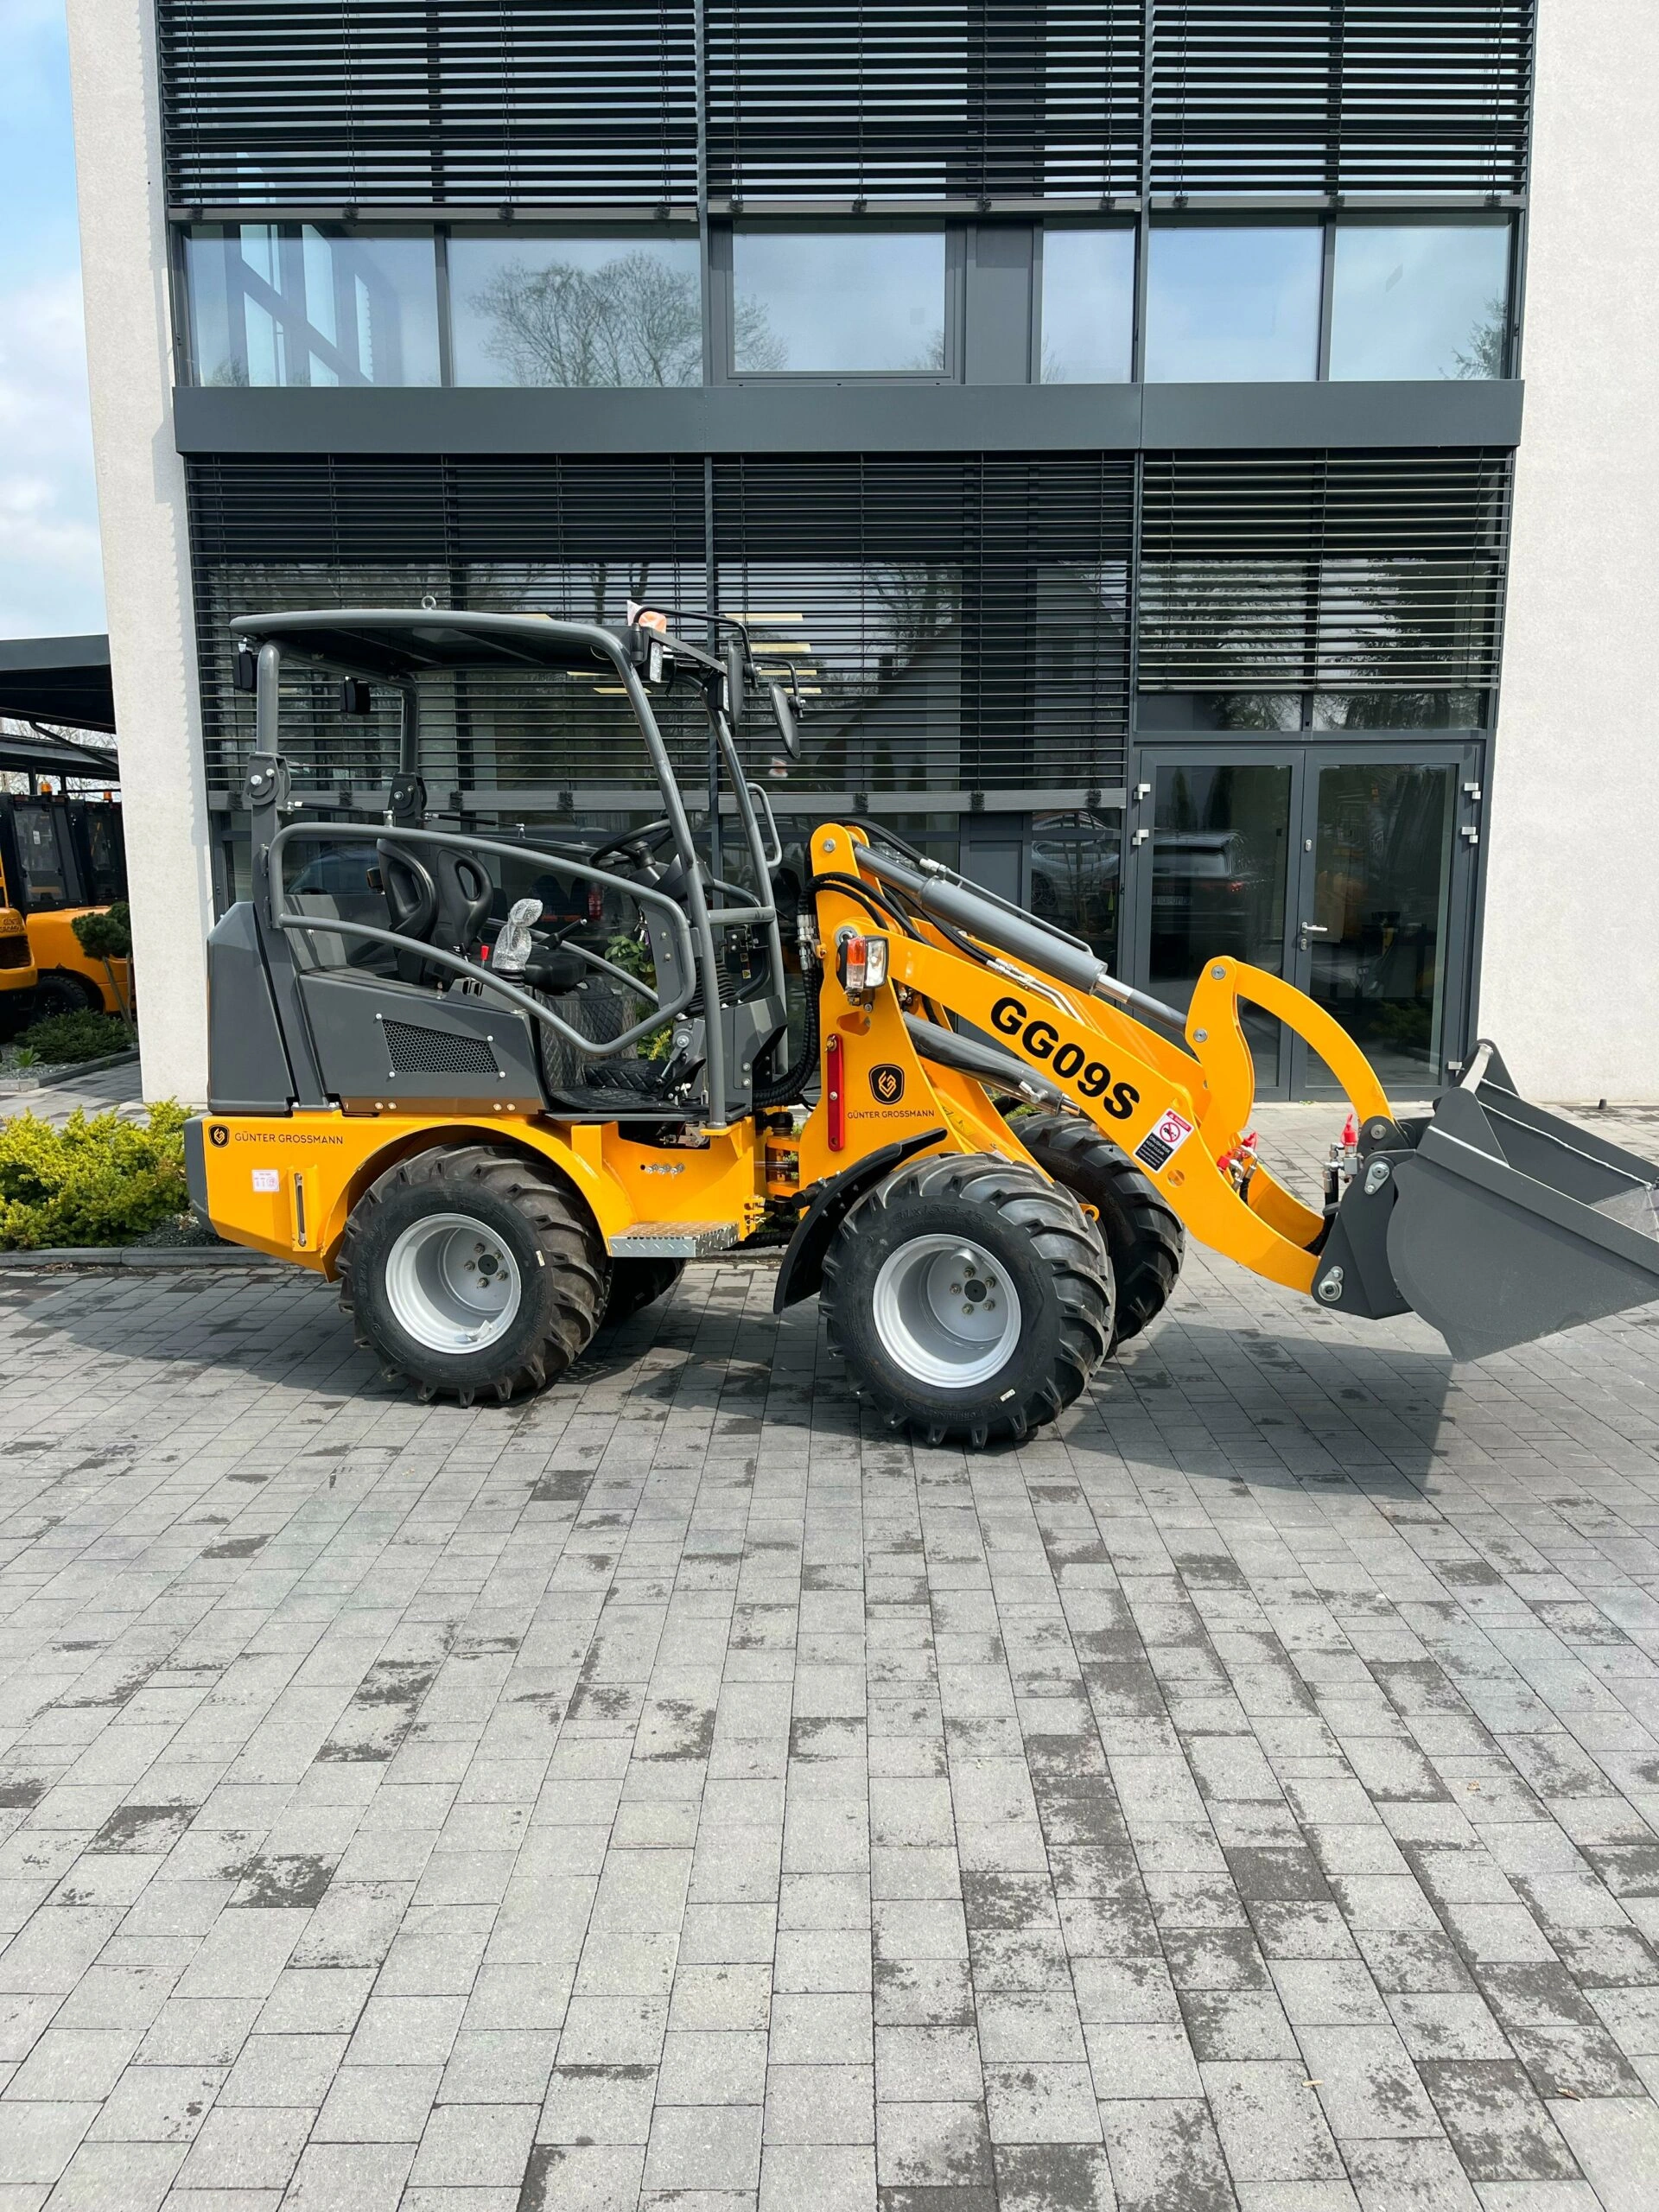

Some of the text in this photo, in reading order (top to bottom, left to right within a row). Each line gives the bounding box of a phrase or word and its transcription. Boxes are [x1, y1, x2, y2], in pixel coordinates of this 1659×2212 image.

[990, 996, 1141, 1120] GG09S
[847, 1109, 935, 1119] GÜNTER GROSSMANN
[235, 1131, 343, 1144] GÜNTER GROSSMANN
